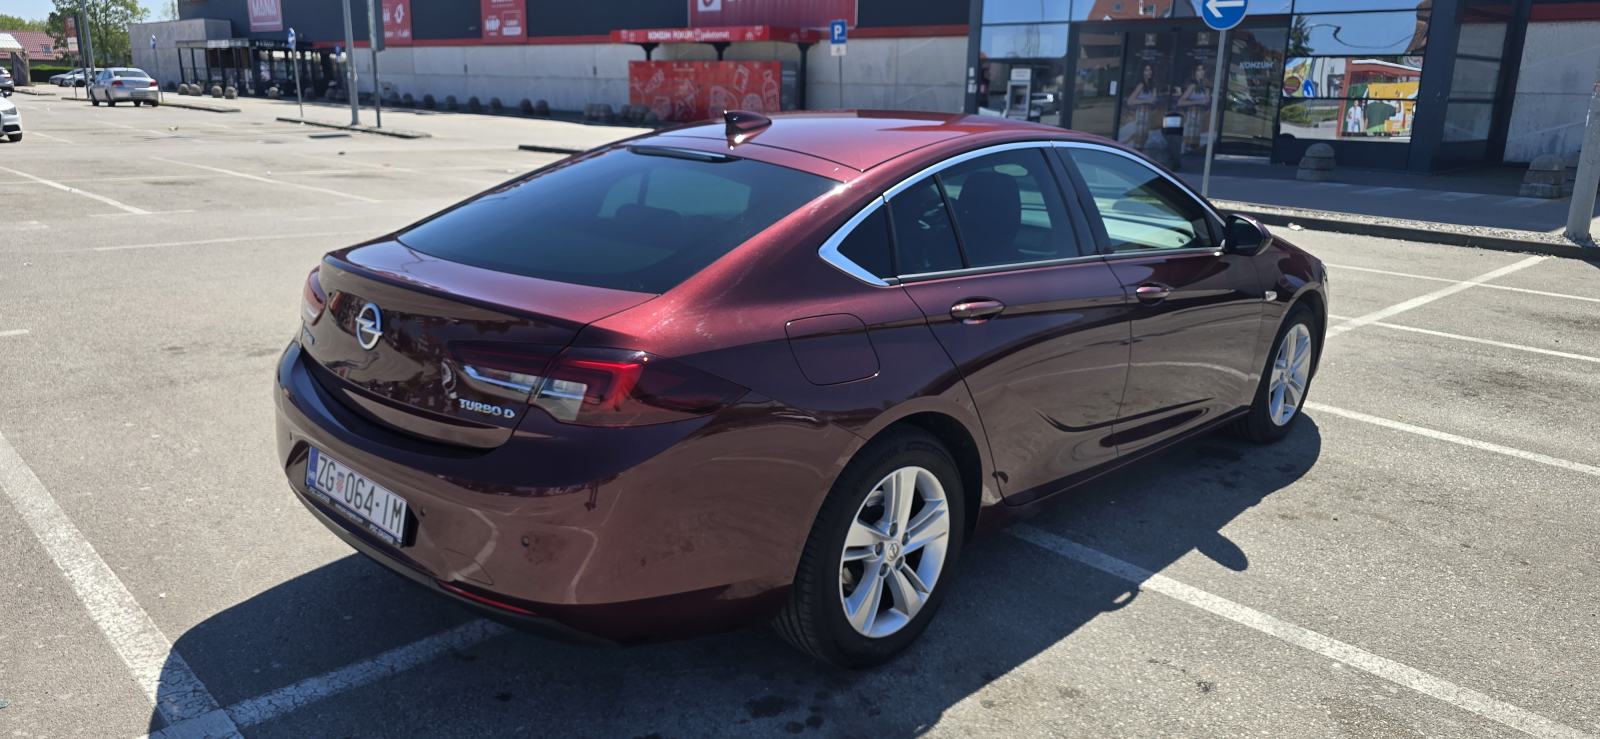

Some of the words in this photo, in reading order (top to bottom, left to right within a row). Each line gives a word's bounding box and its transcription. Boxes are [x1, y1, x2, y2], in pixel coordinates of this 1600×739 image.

[833, 24, 842, 40] P
[458, 398, 502, 416] TURBO
[503, 408, 516, 419] D
[317, 456, 336, 491] ZG
[344, 472, 403, 533] 064-IM
